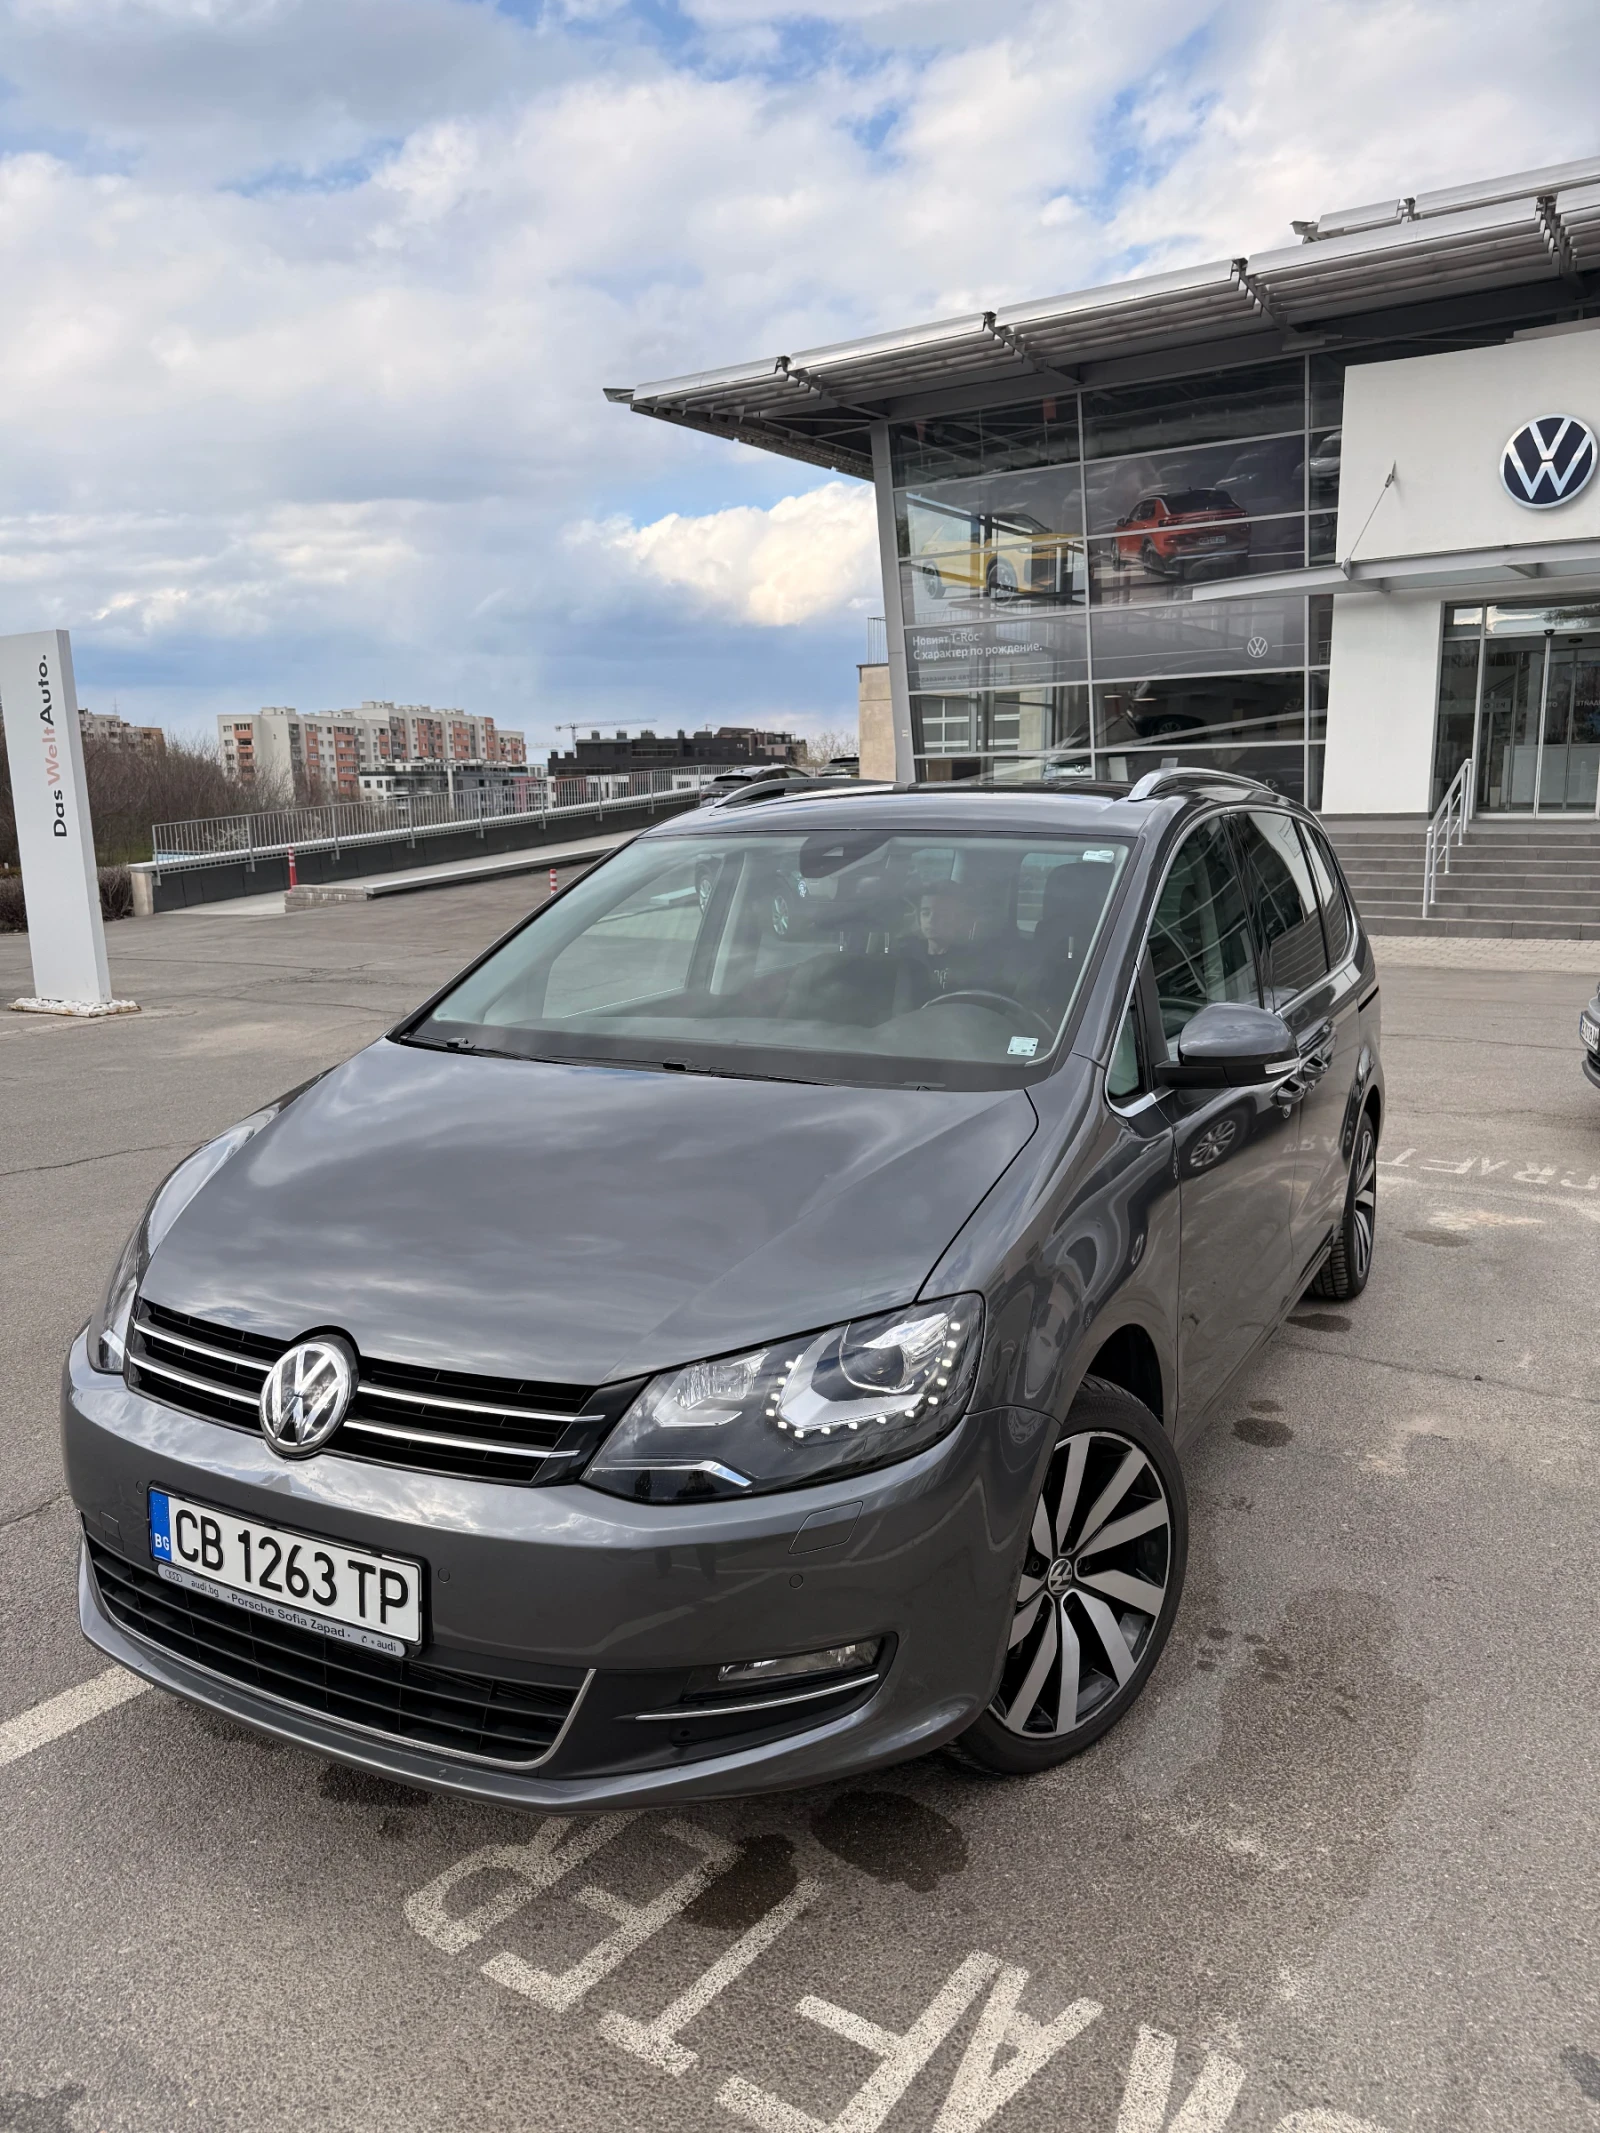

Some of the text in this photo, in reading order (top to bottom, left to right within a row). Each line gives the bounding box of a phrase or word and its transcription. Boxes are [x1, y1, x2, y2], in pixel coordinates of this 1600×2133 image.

[912, 635, 948, 647] Новият
[913, 643, 1042, 661] С характер по рождение.
[53, 789, 67, 837] Das
[154, 1532, 170, 1552] BG
[175, 1508, 409, 1625] CB 1263 TP
[191, 1580, 219, 1598] audi.bg
[231, 1593, 345, 1638] Porsche Sofia Zapad
[376, 1641, 397, 1653] audi
